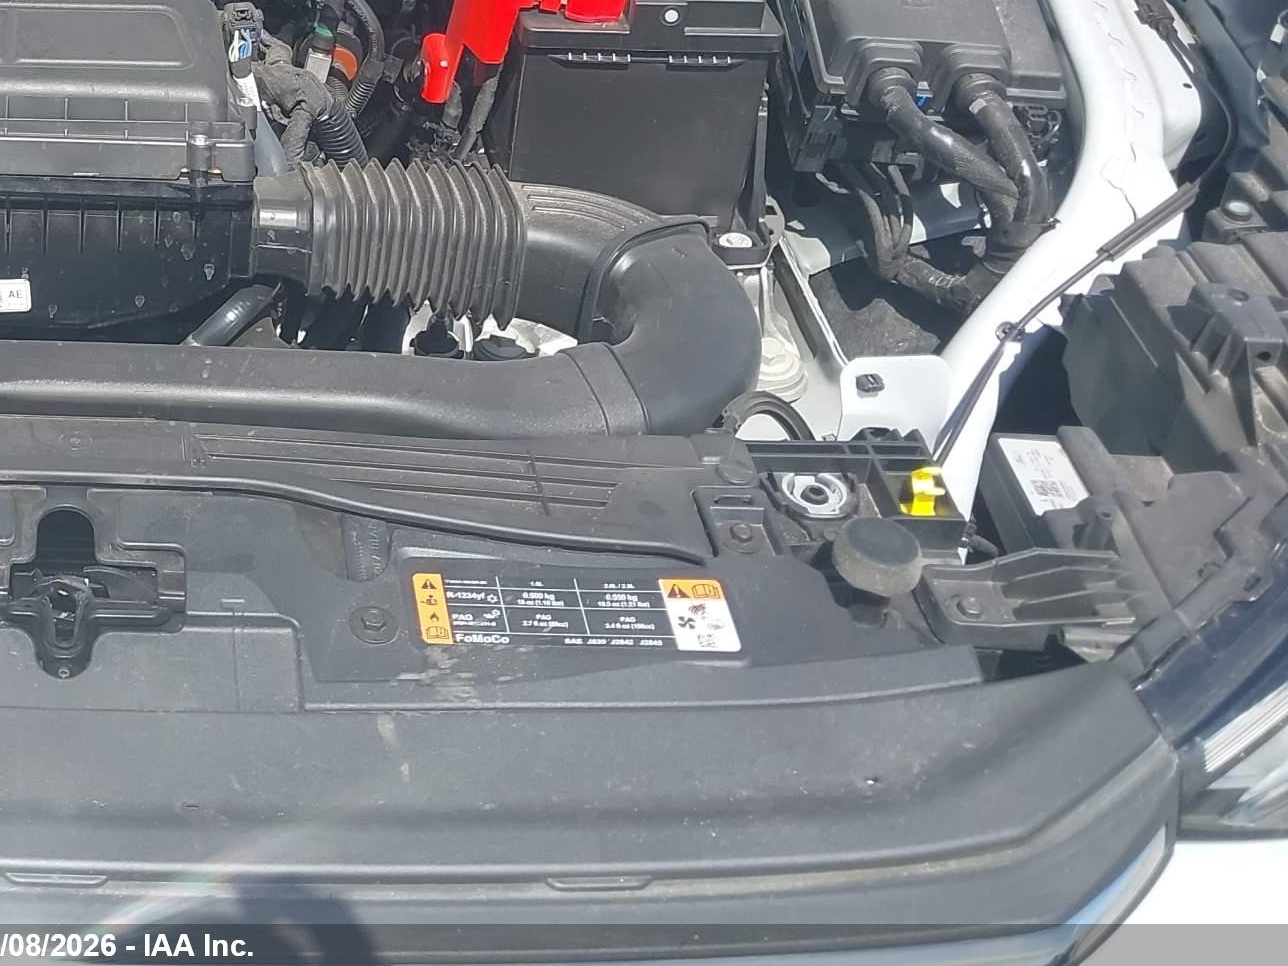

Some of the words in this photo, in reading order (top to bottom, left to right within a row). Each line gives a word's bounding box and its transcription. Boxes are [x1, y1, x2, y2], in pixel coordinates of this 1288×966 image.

[8, 289, 23, 299] AE
[455, 634, 510, 644] FoMoCo
[564, 637, 583, 645] SAE
